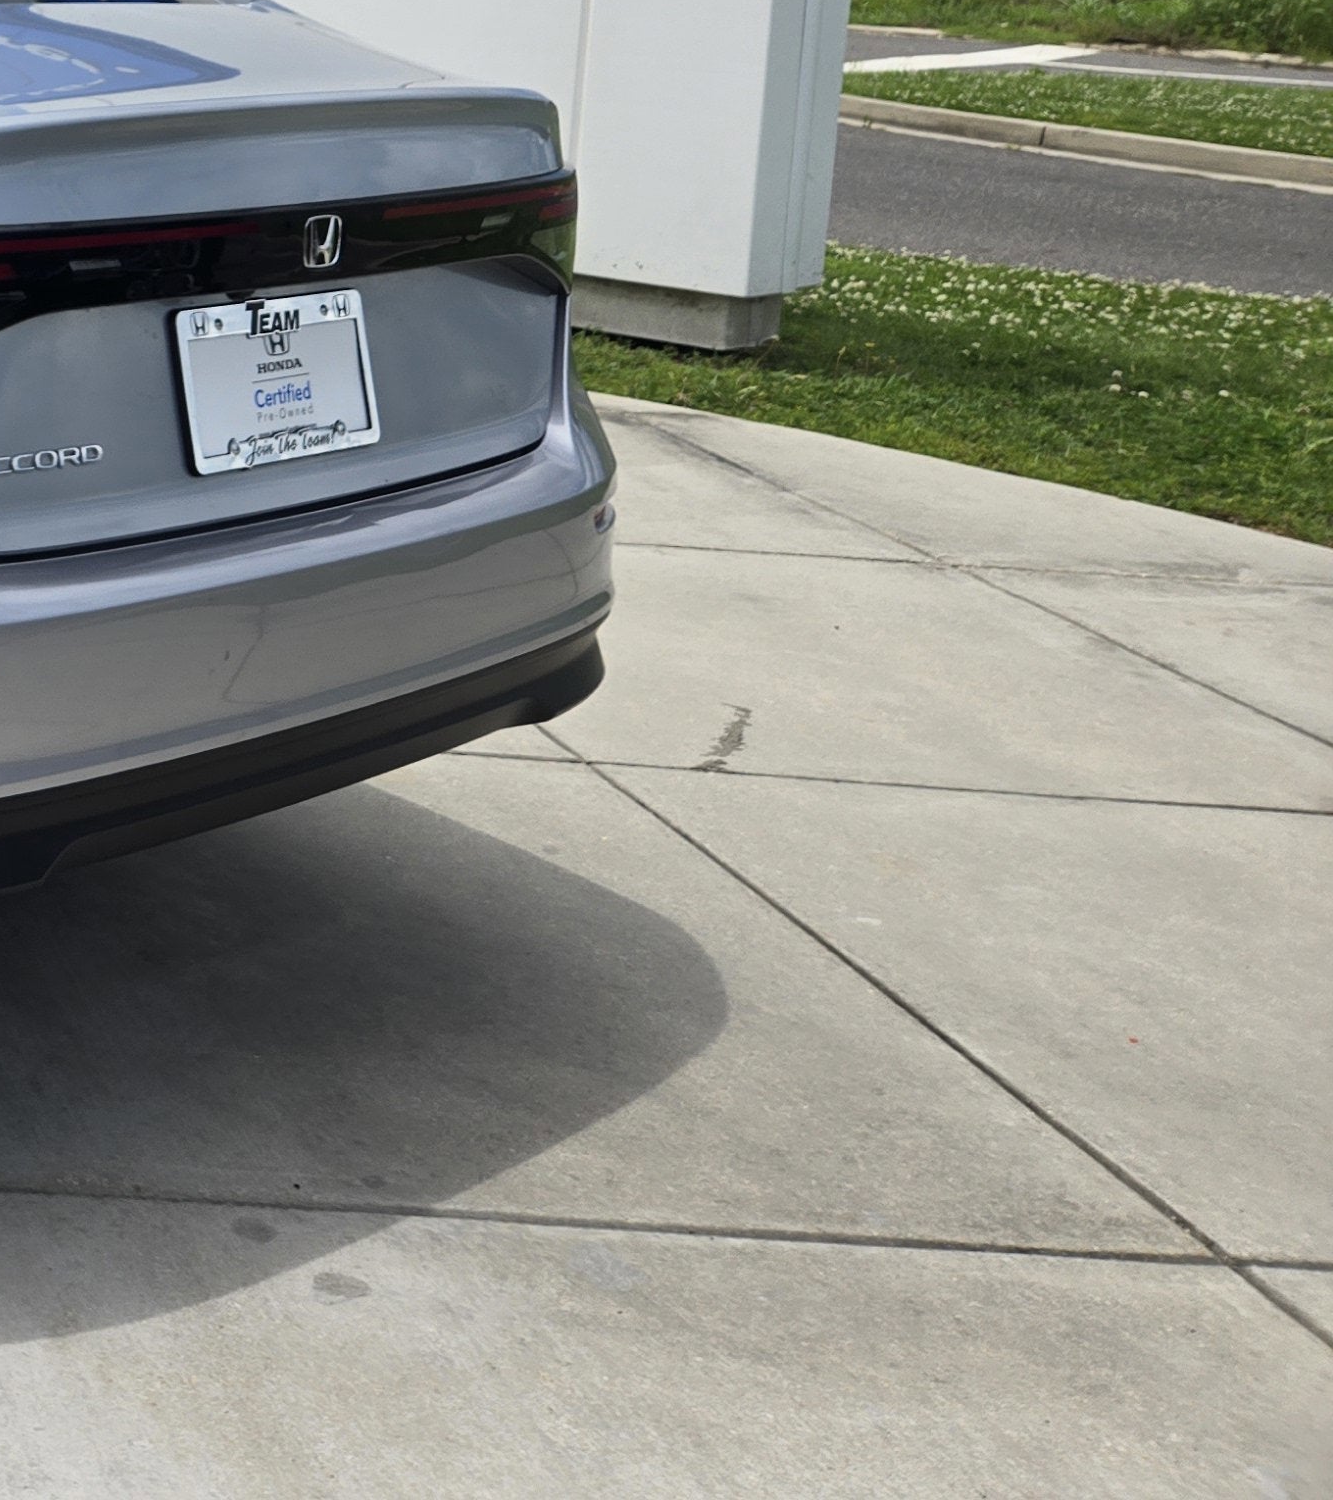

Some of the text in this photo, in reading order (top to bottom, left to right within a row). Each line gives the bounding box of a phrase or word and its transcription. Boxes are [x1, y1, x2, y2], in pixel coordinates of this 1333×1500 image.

[245, 301, 300, 336] TEAM
[256, 357, 303, 375] HONDA
[254, 380, 312, 408] Certified
[256, 405, 315, 424] Pre-Owned
[245, 437, 274, 467] Join
[274, 430, 298, 454] The
